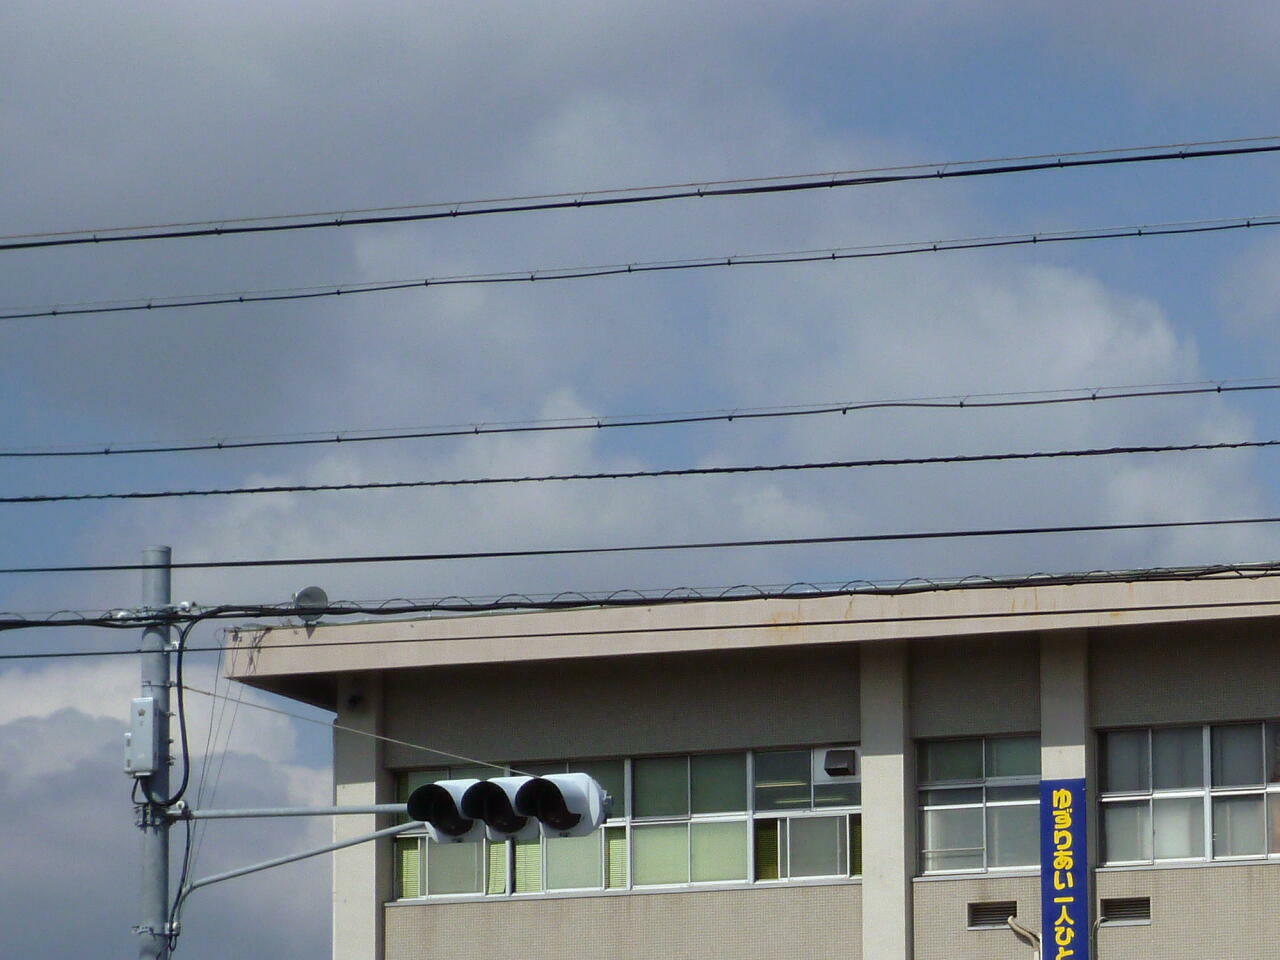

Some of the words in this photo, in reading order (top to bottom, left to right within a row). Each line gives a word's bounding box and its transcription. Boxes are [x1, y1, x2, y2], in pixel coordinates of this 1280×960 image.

[1052, 788, 1074, 890] ゆずりあい
